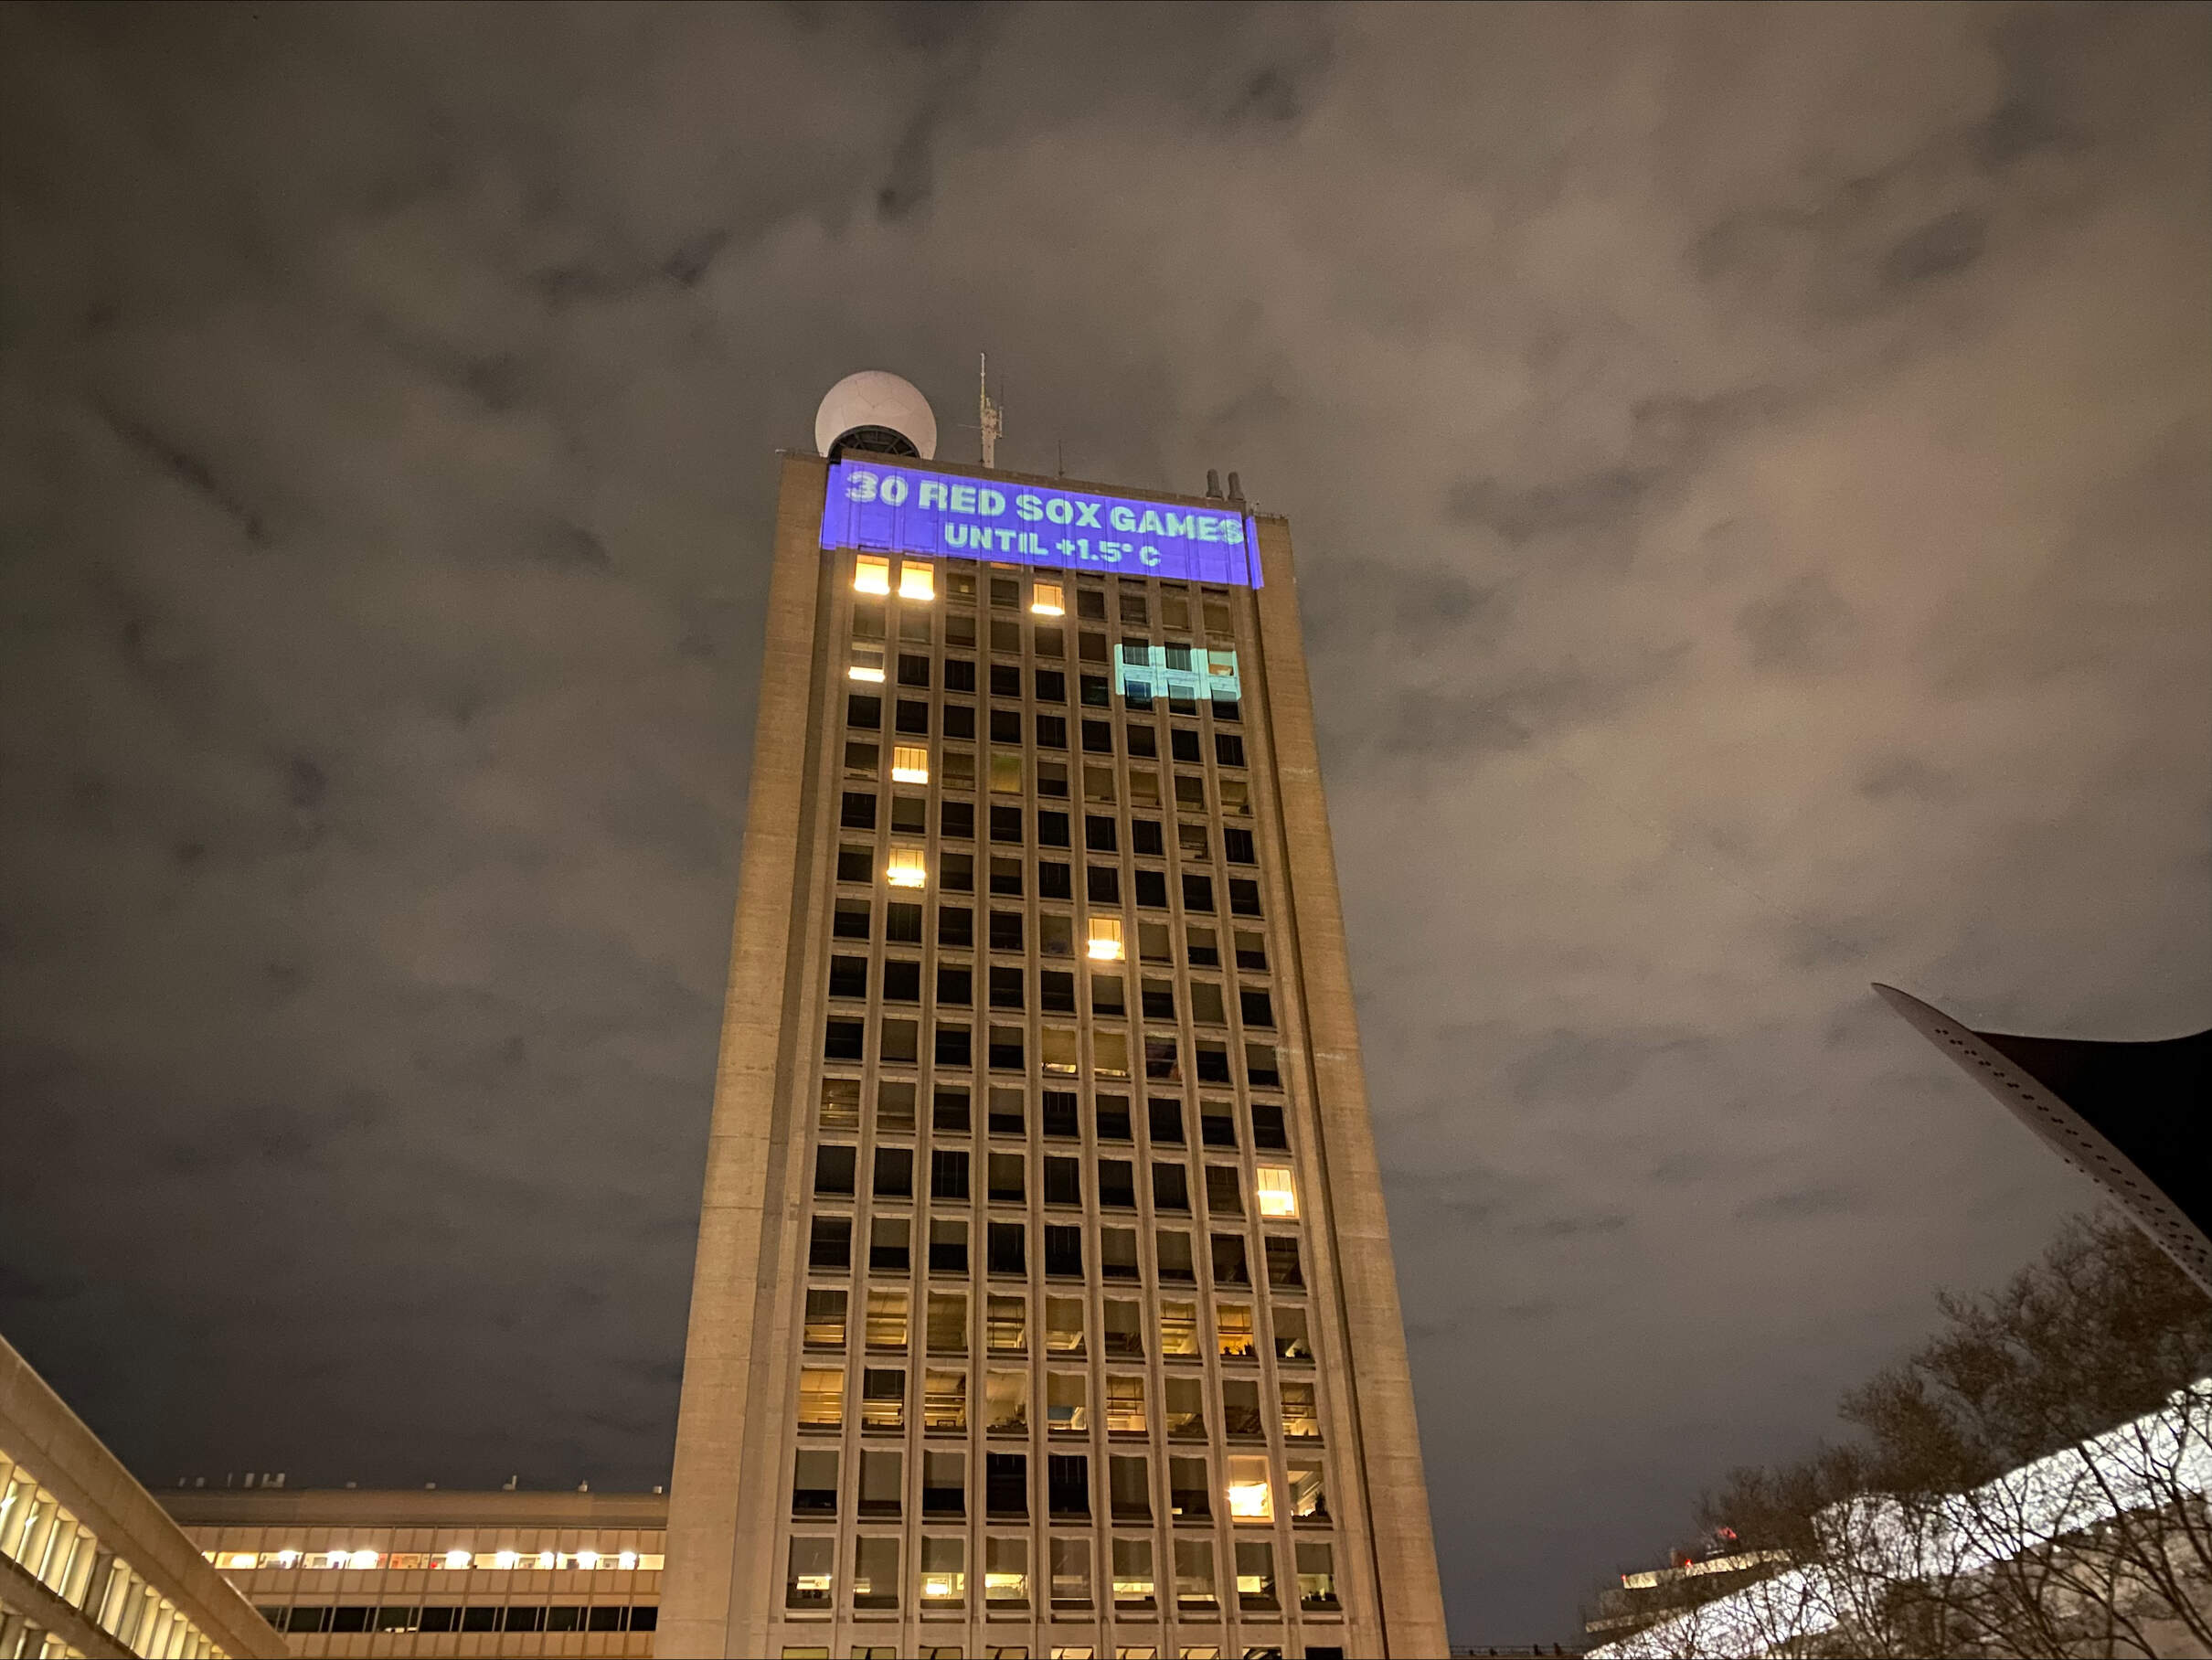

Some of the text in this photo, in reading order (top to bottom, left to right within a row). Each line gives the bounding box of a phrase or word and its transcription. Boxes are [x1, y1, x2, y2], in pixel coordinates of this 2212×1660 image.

[845, 472, 1243, 546] 30 RED SOX GAMES
[945, 522, 1048, 556] UNTIL
[1141, 548, 1161, 567] C
